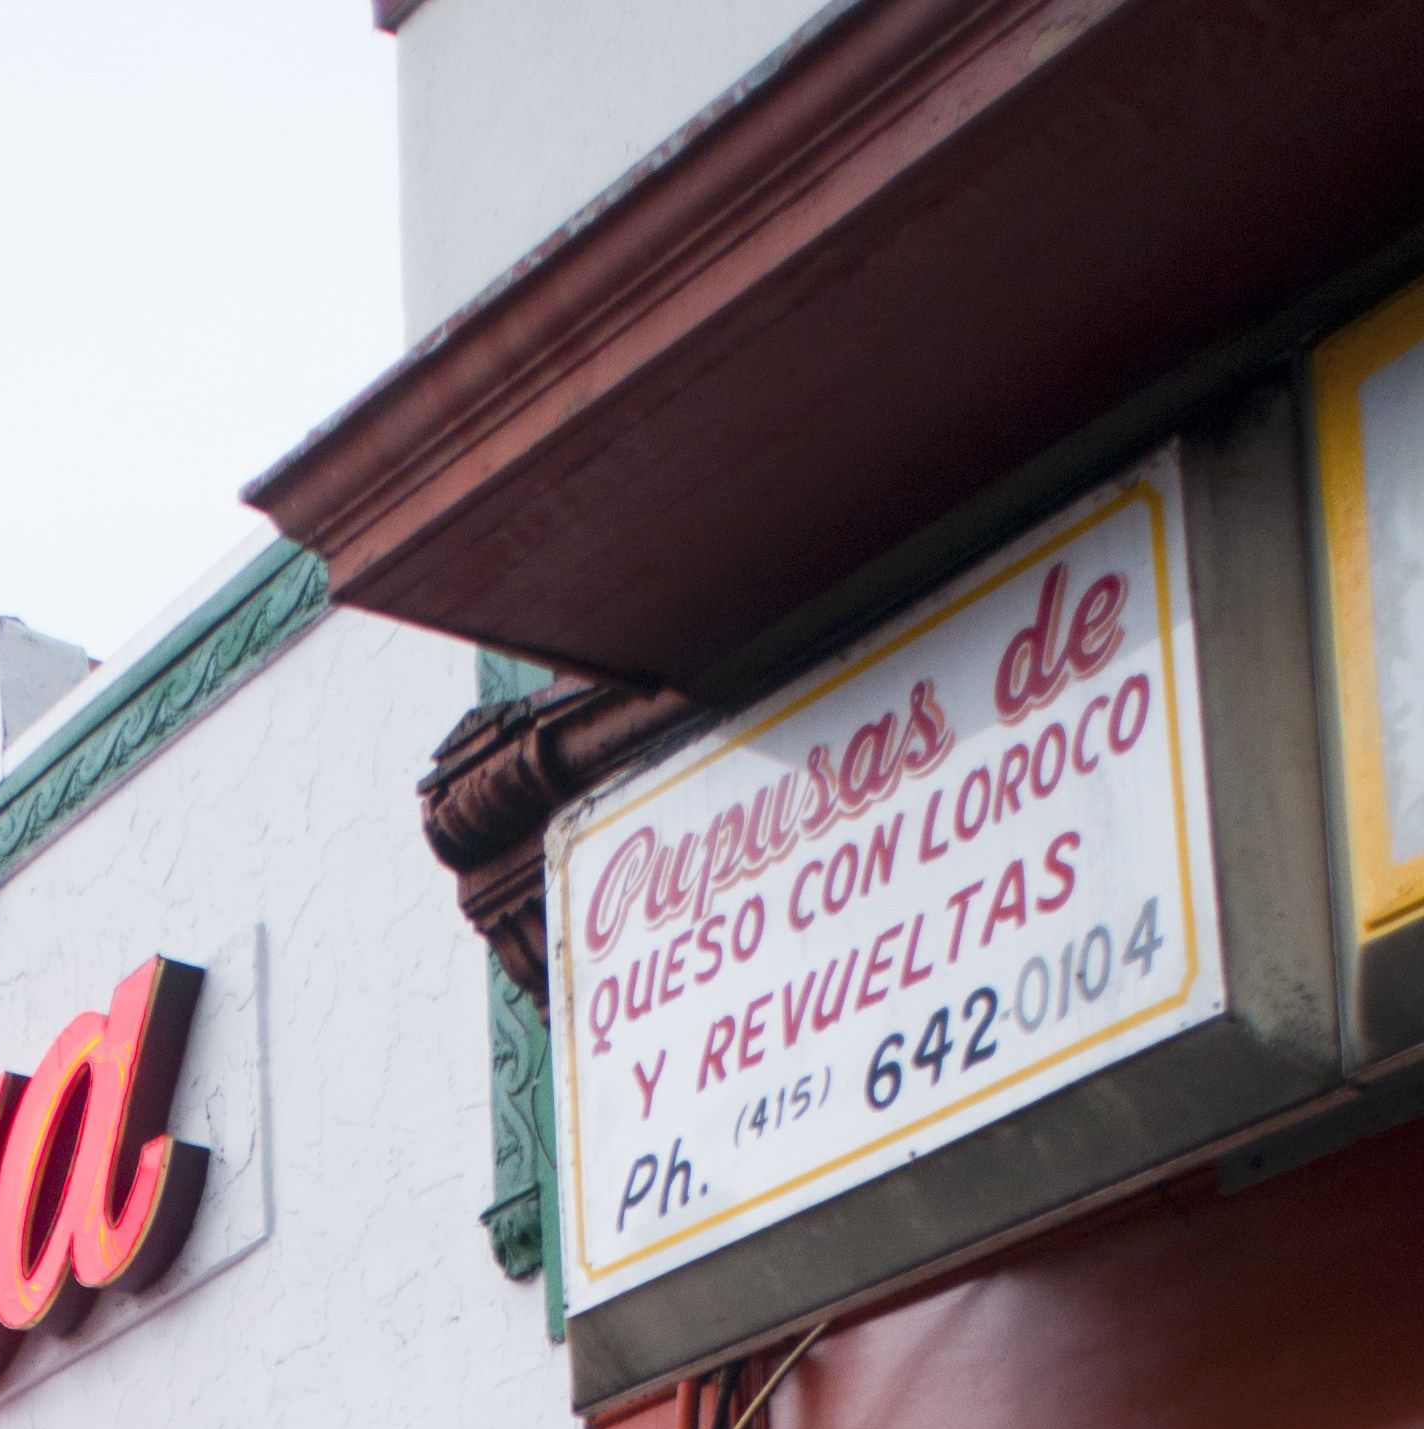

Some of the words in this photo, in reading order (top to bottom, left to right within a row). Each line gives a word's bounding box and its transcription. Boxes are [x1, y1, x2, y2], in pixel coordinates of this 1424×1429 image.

[582, 679, 955, 965] Pupusas
[993, 561, 1128, 728] de
[588, 893, 765, 1058] QUESO
[787, 811, 904, 933] CON
[917, 672, 1151, 866] LOROCO
[616, 1136, 709, 1233] Ph.
[734, 1065, 832, 1150] (415)
[864, 895, 1164, 1113] 642-0104
[632, 1048, 667, 1122] Y
[696, 831, 1082, 1093] REVUELTAS
